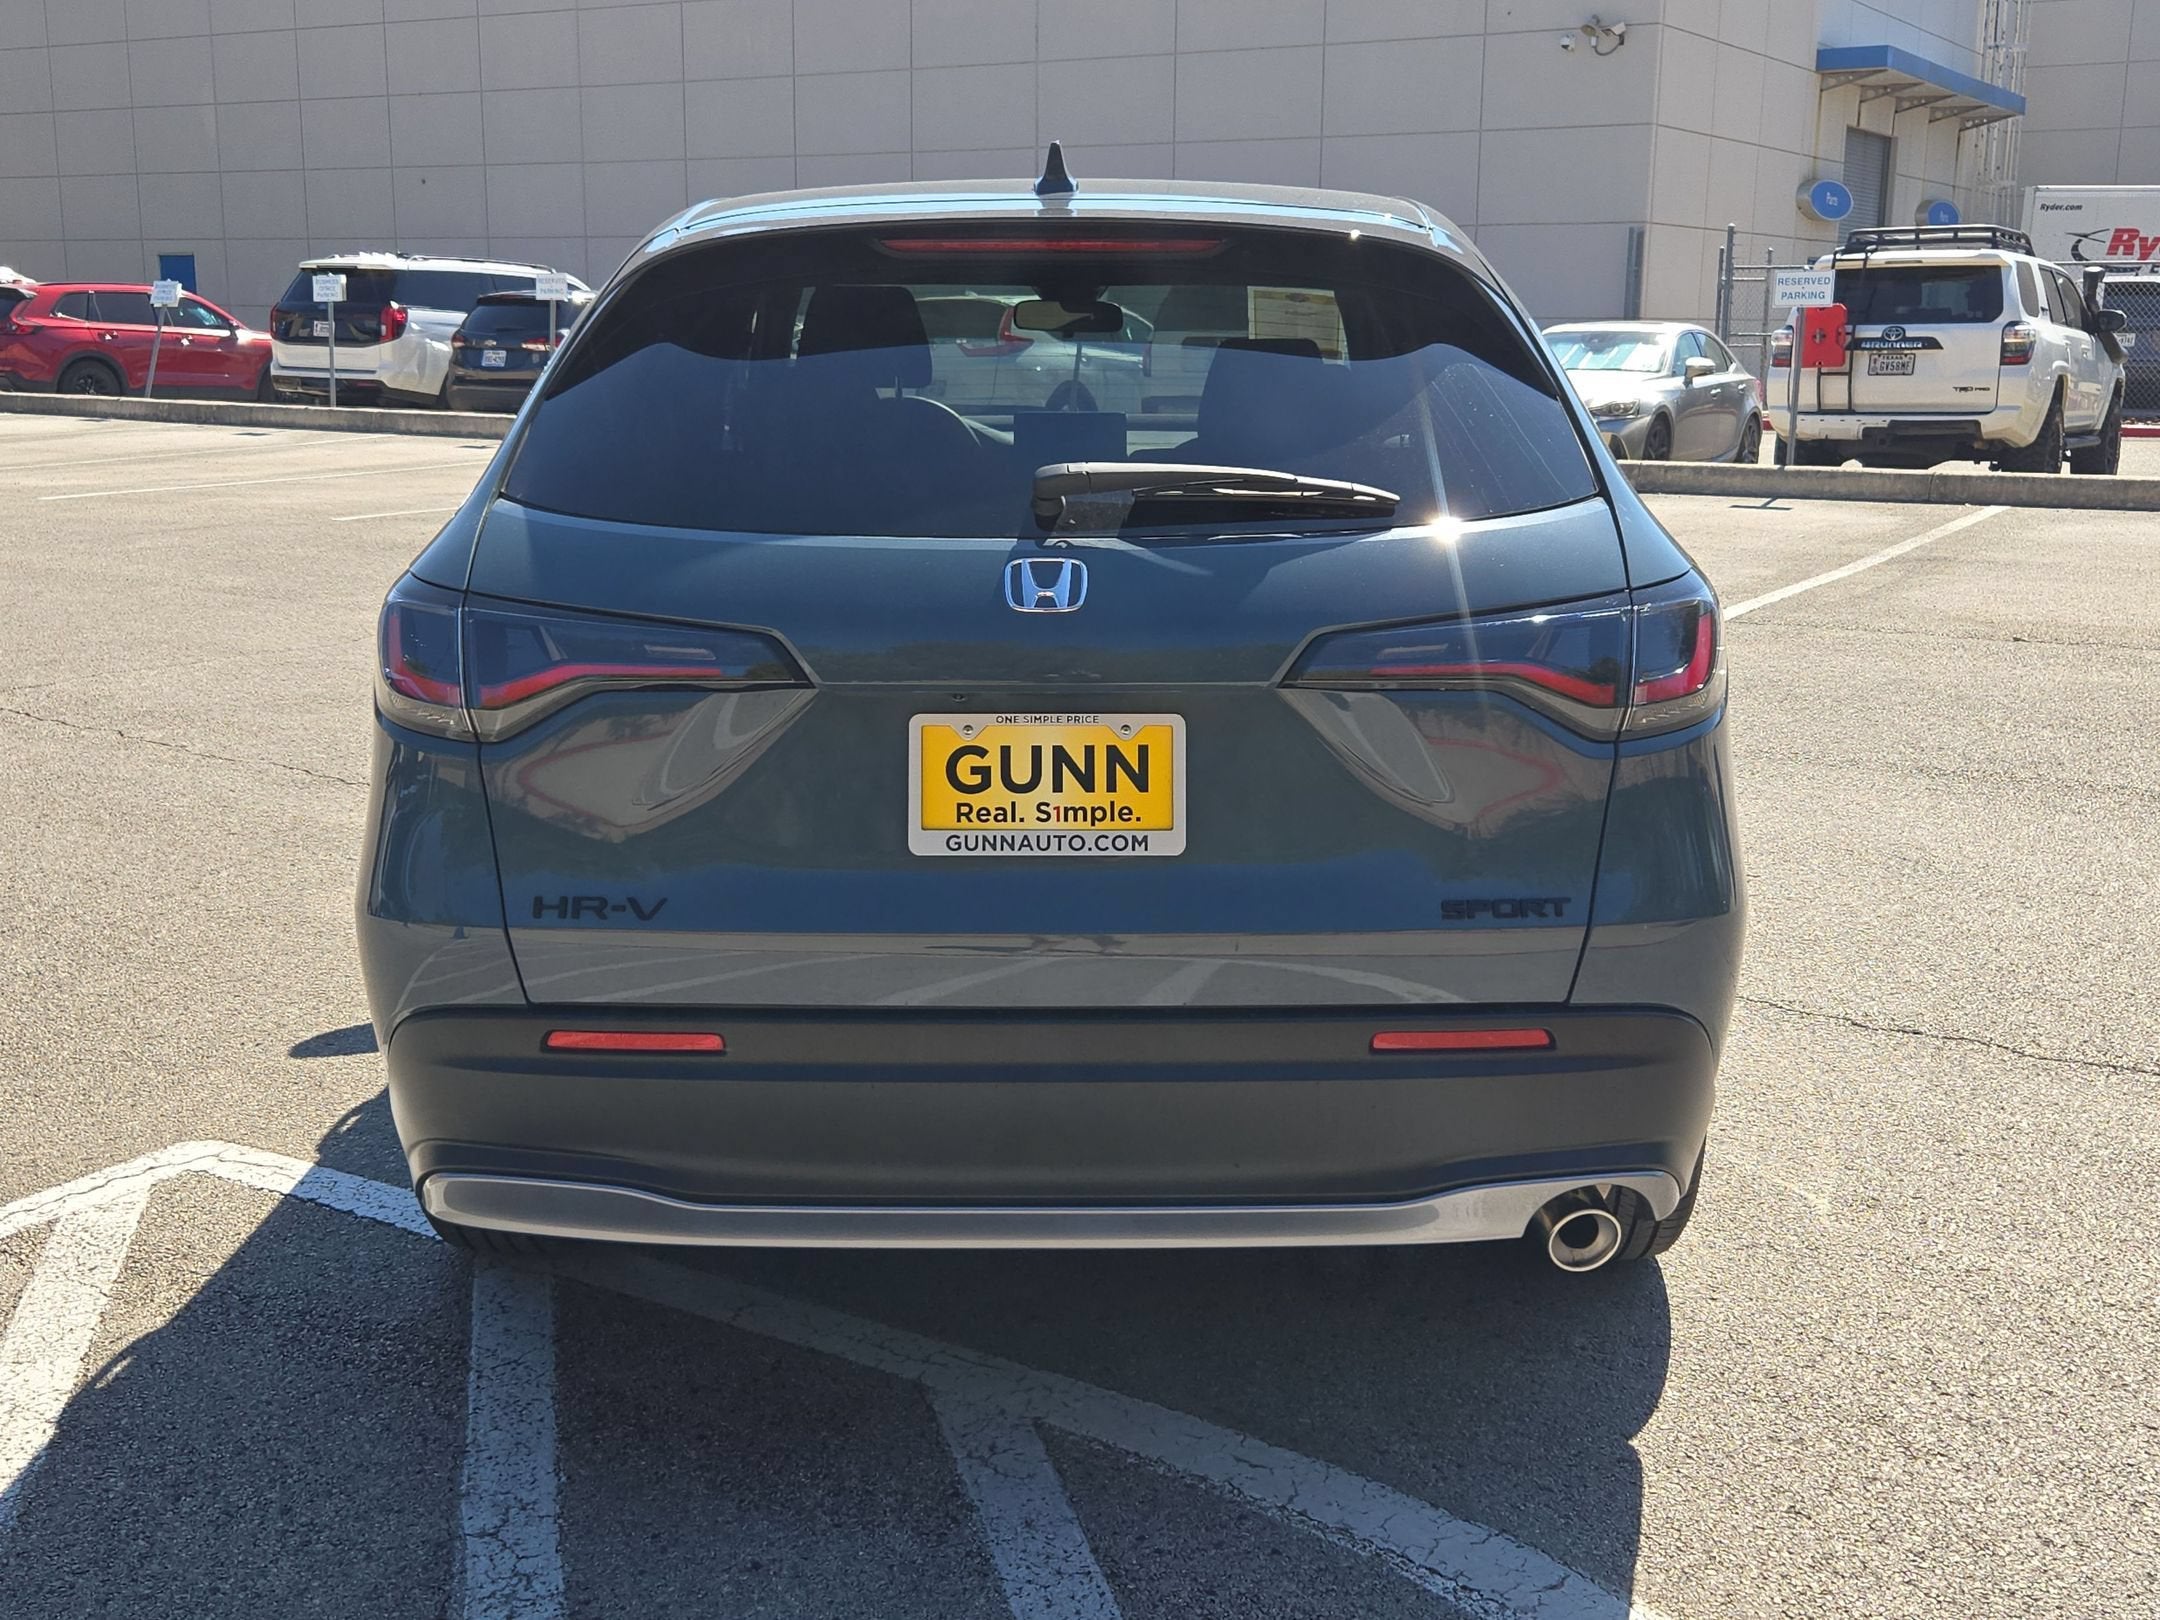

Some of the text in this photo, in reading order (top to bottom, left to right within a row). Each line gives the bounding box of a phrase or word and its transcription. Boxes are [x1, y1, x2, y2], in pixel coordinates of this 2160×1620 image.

[2040, 203, 2083, 212] Ryder.com
[1777, 277, 1831, 286] RESERVED
[1781, 291, 1826, 300] PARKING
[995, 715, 1100, 724] ONE SIMPLE PRICE
[945, 744, 1149, 795] GUNN
[956, 801, 1025, 823] Real.
[945, 834, 1149, 852] GUNNAUTO.COM
[532, 895, 668, 921] HR-V
[1441, 897, 1572, 920] SPORT
